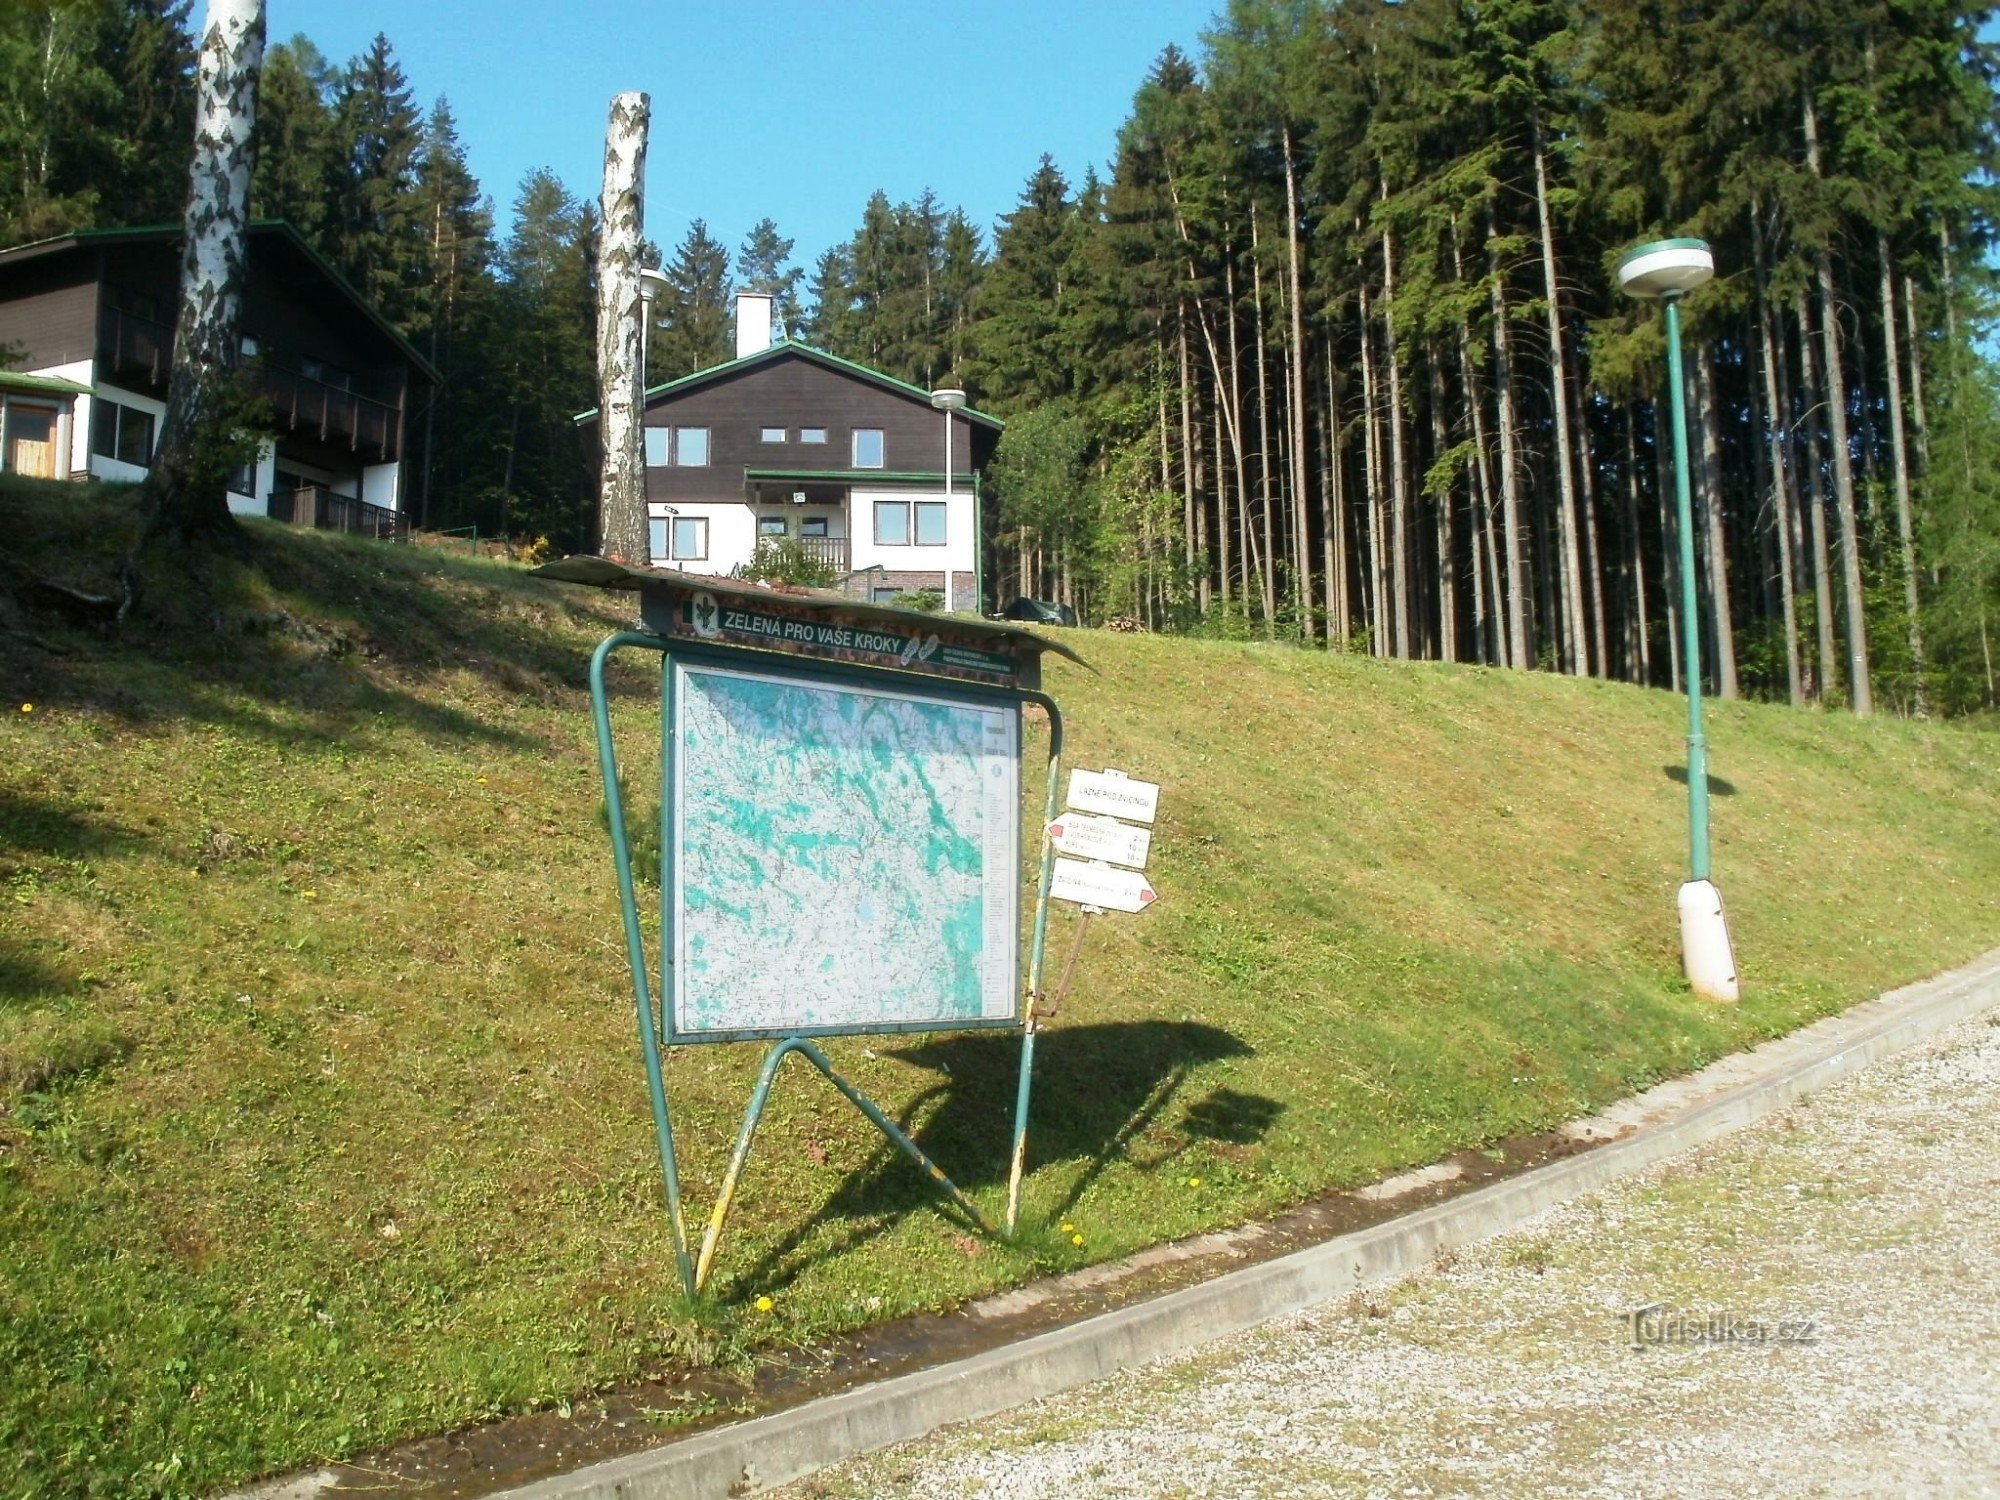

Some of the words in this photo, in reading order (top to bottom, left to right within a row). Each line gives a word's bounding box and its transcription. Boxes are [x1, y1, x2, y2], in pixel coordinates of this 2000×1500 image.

[725, 611, 781, 636] ZELENÁ
[784, 622, 814, 641] PRO
[817, 626, 852, 647] VAŠE
[855, 633, 900, 653] KROKY
